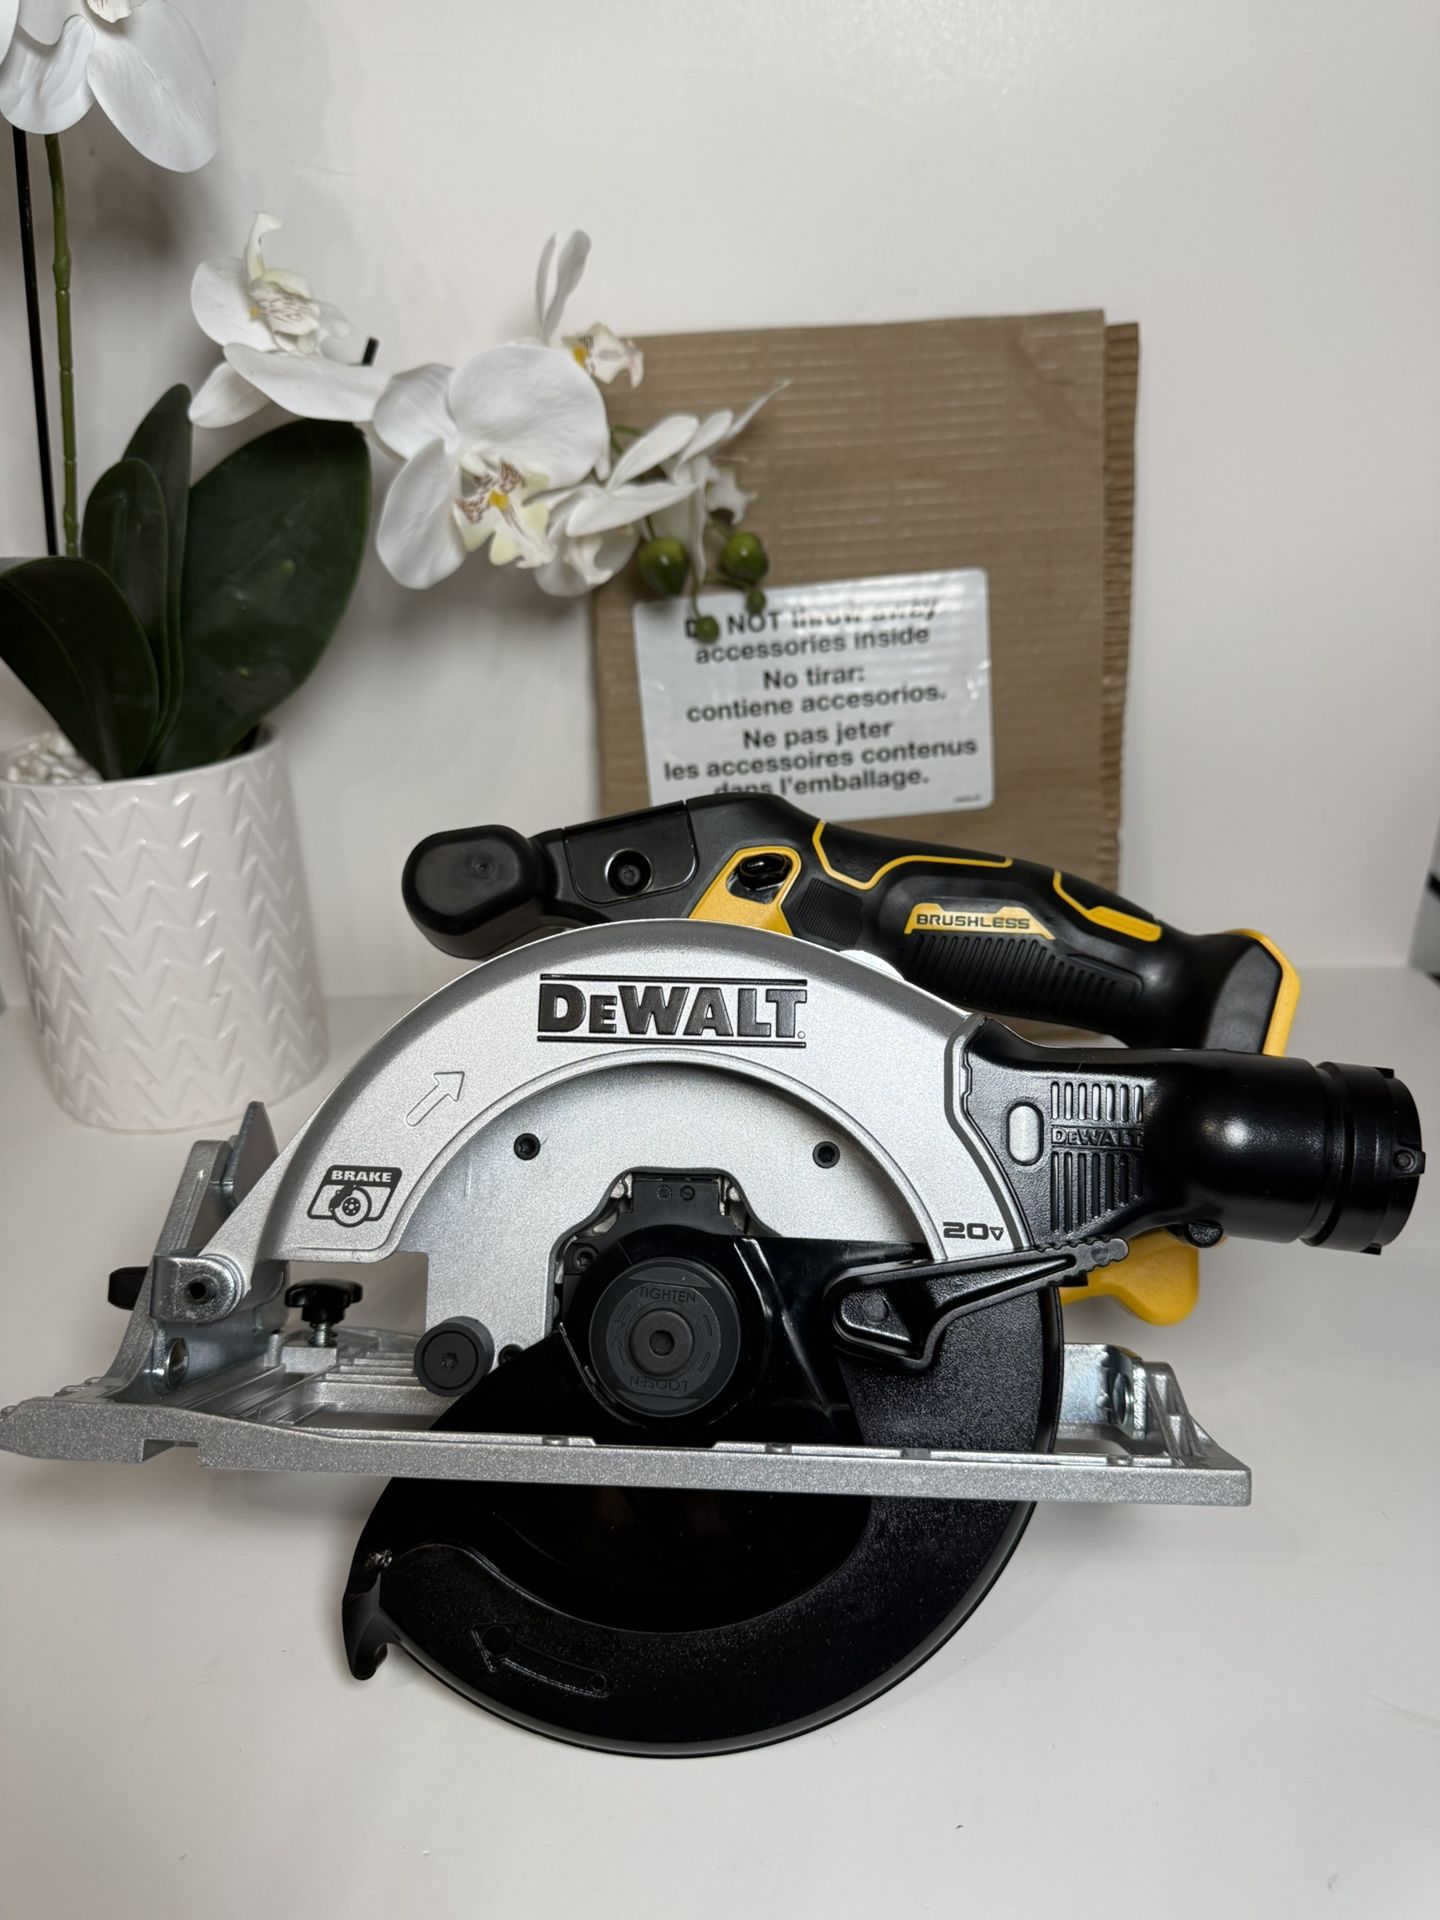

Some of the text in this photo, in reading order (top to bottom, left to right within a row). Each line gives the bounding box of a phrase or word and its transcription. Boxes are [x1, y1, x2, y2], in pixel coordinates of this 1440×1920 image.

[727, 611, 781, 635] NOT
[695, 626, 929, 664] accessories inside
[763, 665, 864, 690] No tirar:
[686, 685, 946, 723] contiene accesorios.
[743, 721, 892, 750] Ne pas jeter
[664, 738, 978, 781] les accessoires contenus
[780, 768, 929, 795] l'emballage.
[916, 913, 1030, 930] BRUSHLESS
[537, 982, 807, 1038] DEWALT
[330, 1169, 393, 1183] BRAKE
[639, 1285, 697, 1304] TIGHTEN
[629, 1375, 688, 1393] LOOSEN
